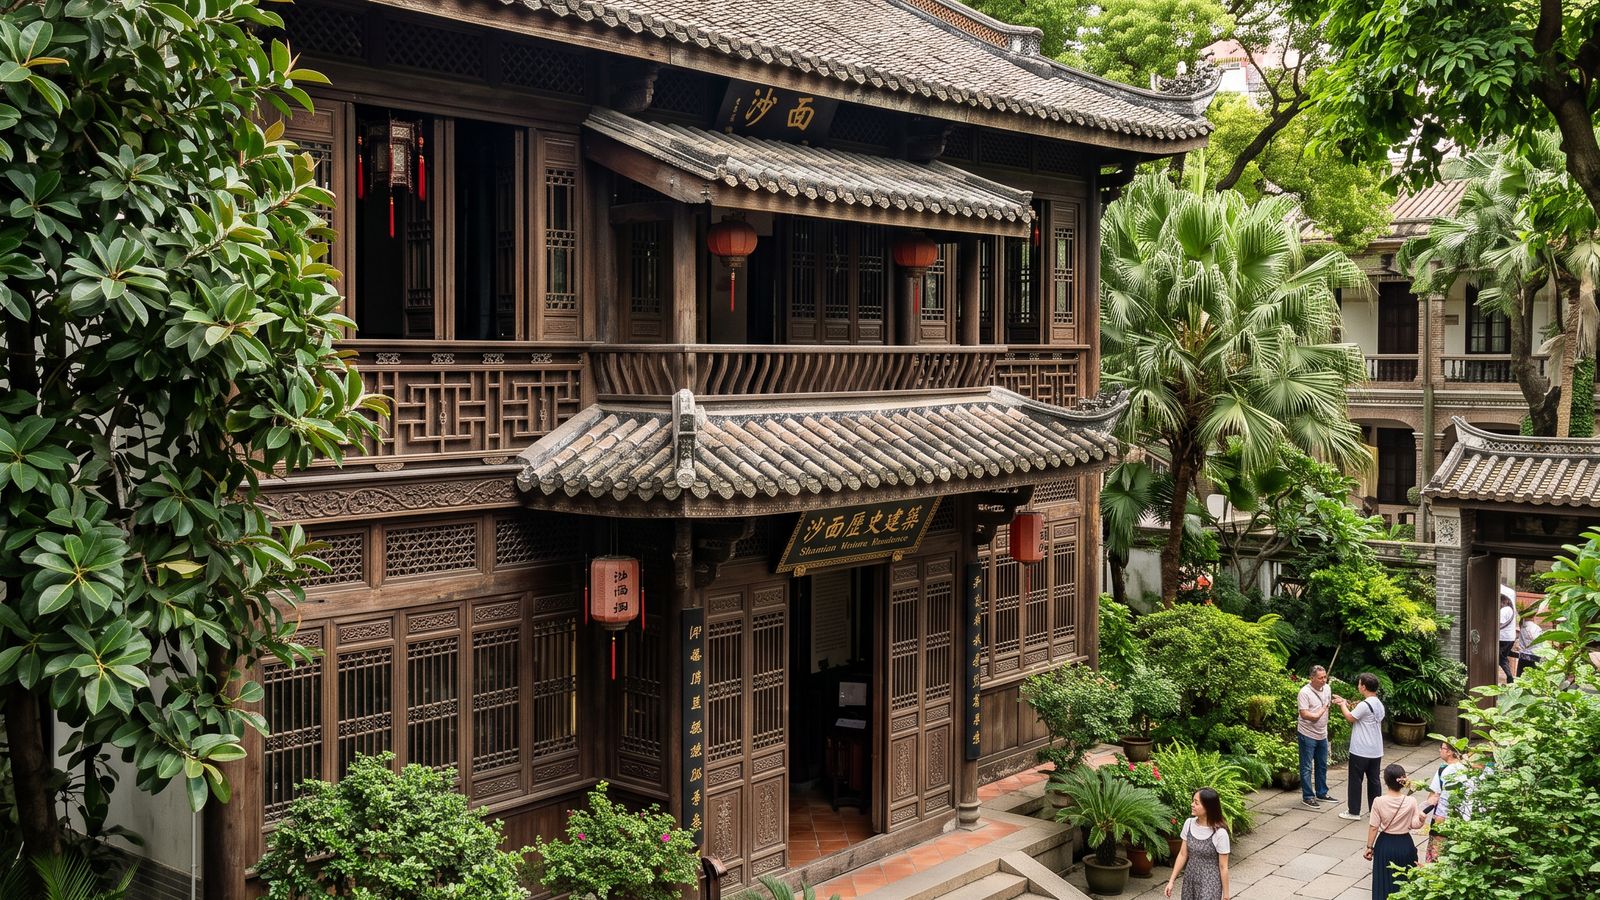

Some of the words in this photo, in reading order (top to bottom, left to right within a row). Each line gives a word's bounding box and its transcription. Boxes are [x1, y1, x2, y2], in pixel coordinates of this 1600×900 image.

[745, 87, 815, 131] 沙面
[803, 504, 923, 544] 沙面歷史建築
[799, 544, 837, 557] Shamian
